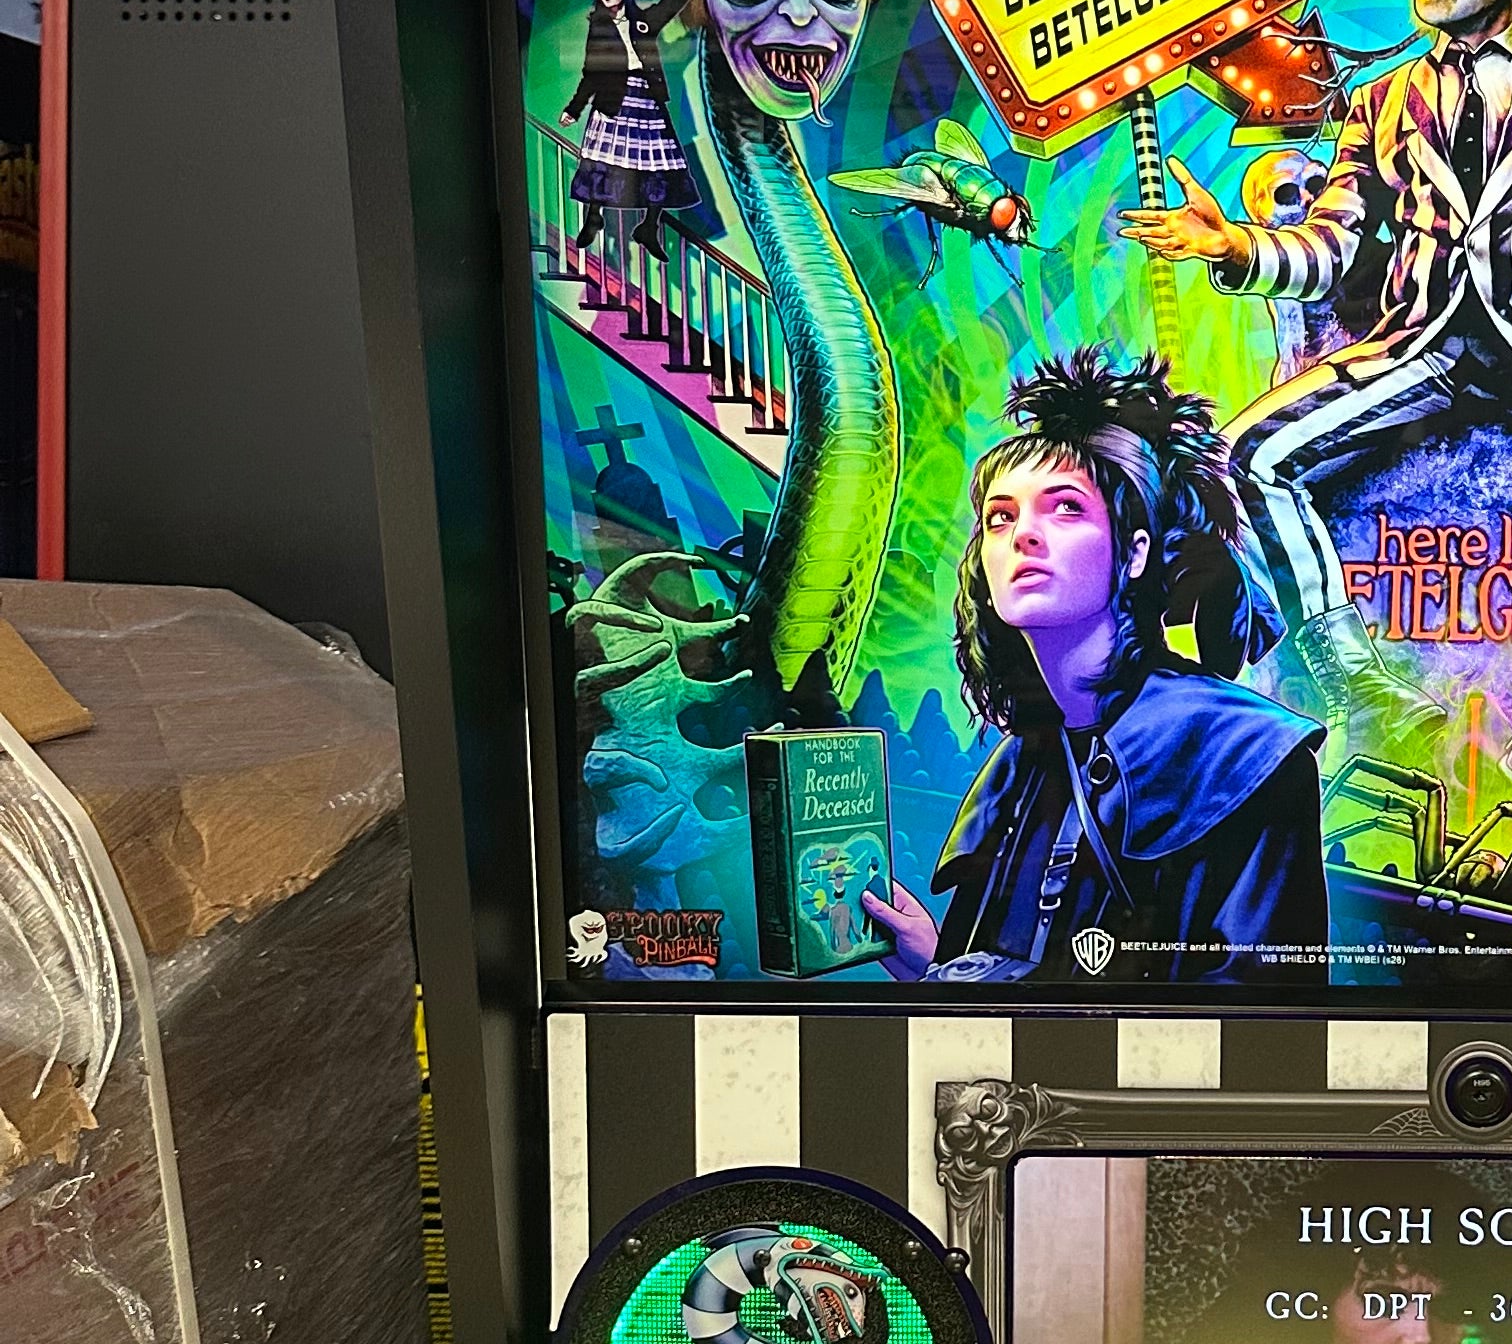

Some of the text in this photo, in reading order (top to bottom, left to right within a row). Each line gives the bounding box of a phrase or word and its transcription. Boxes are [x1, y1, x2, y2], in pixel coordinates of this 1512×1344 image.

[1377, 513, 1488, 566] here
[804, 737, 861, 752] HANDBOOK
[813, 750, 856, 765] FOR THE
[803, 765, 870, 798] Recently
[801, 790, 876, 822] Deceased
[605, 910, 723, 942] SPOOKY
[635, 934, 719, 966] PINBALL
[1076, 930, 1112, 970] WB
[1120, 941, 1188, 953] BEETLEJUICE
[1189, 942, 1208, 952] and
[1222, 942, 1254, 953] related
[1255, 942, 1303, 954] characters
[1304, 943, 1323, 953] and
[1404, 945, 1437, 955] Warner
[1438, 945, 1462, 956] Bros.
[1260, 954, 1278, 964] WB
[1280, 954, 1317, 964] SHIELD
[1298, 1205, 1433, 1245] HIGH
[1265, 1291, 1330, 1321] GC:
[1361, 1292, 1433, 1321] DPT
